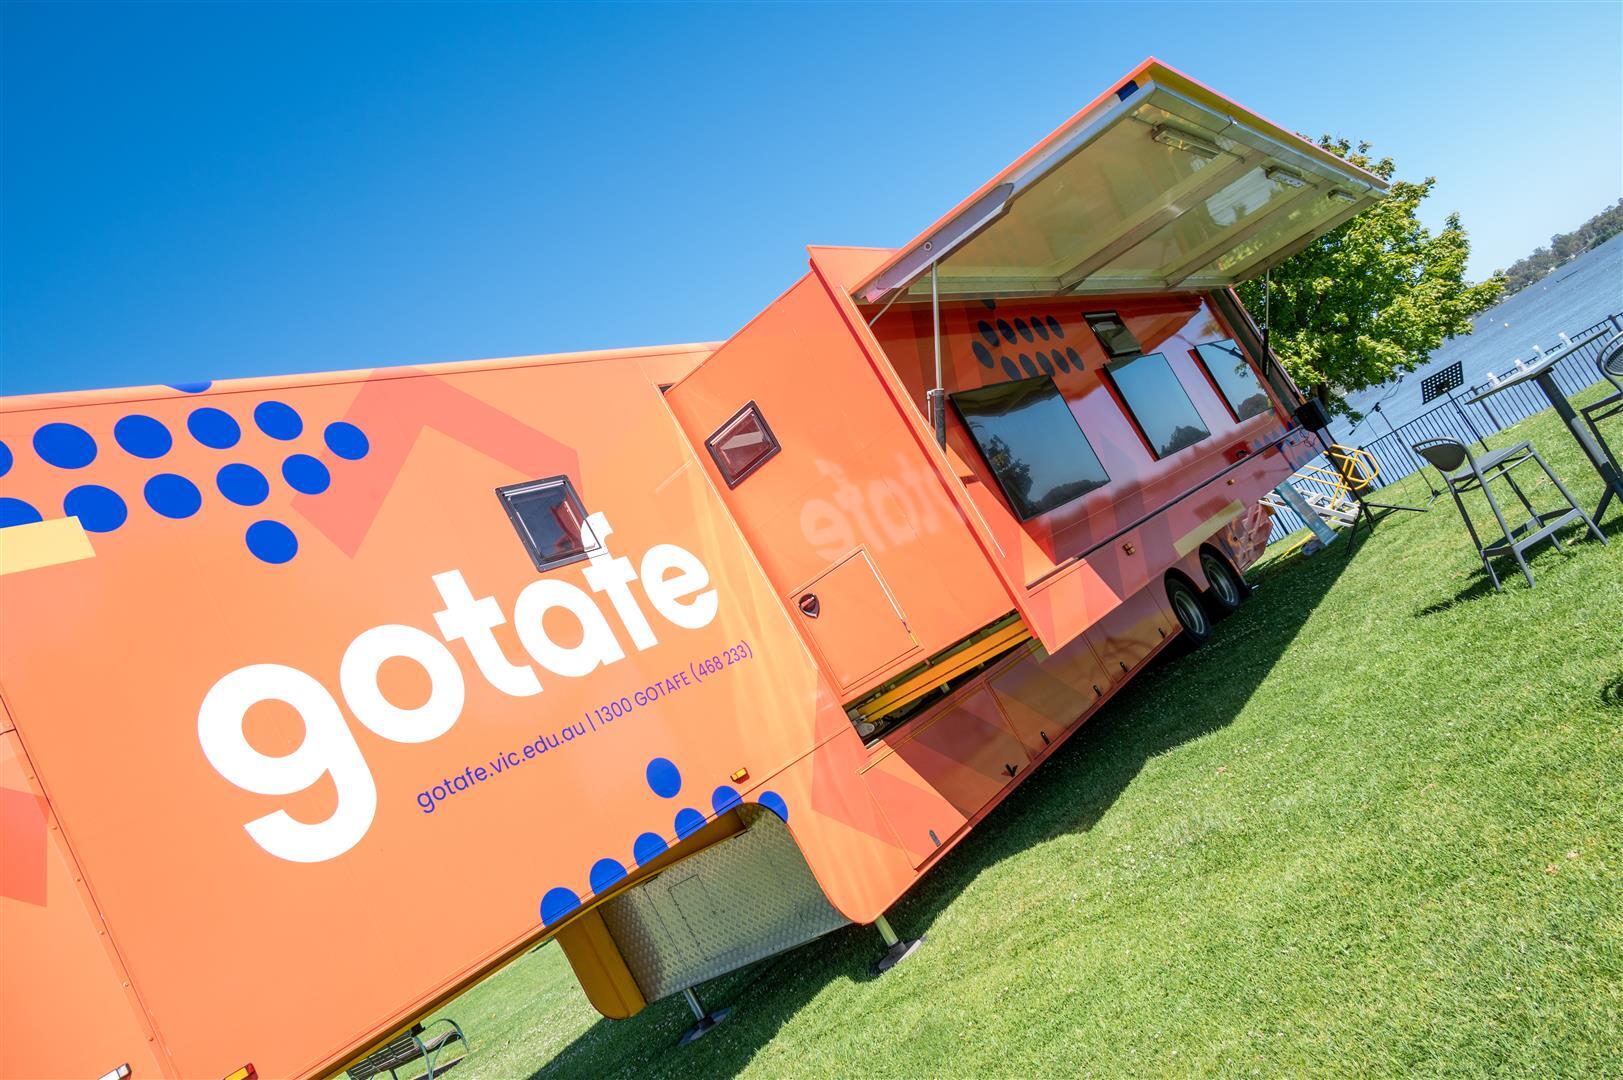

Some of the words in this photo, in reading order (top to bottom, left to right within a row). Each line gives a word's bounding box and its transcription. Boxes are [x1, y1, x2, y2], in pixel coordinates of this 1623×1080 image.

[197, 511, 718, 863] gotafe
[416, 721, 587, 814] gotafe.vic.edu.au
[594, 697, 633, 725] 1300
[633, 672, 691, 707] GOTAFE
[689, 657, 724, 683] (468
[722, 639, 754, 667] 233)
